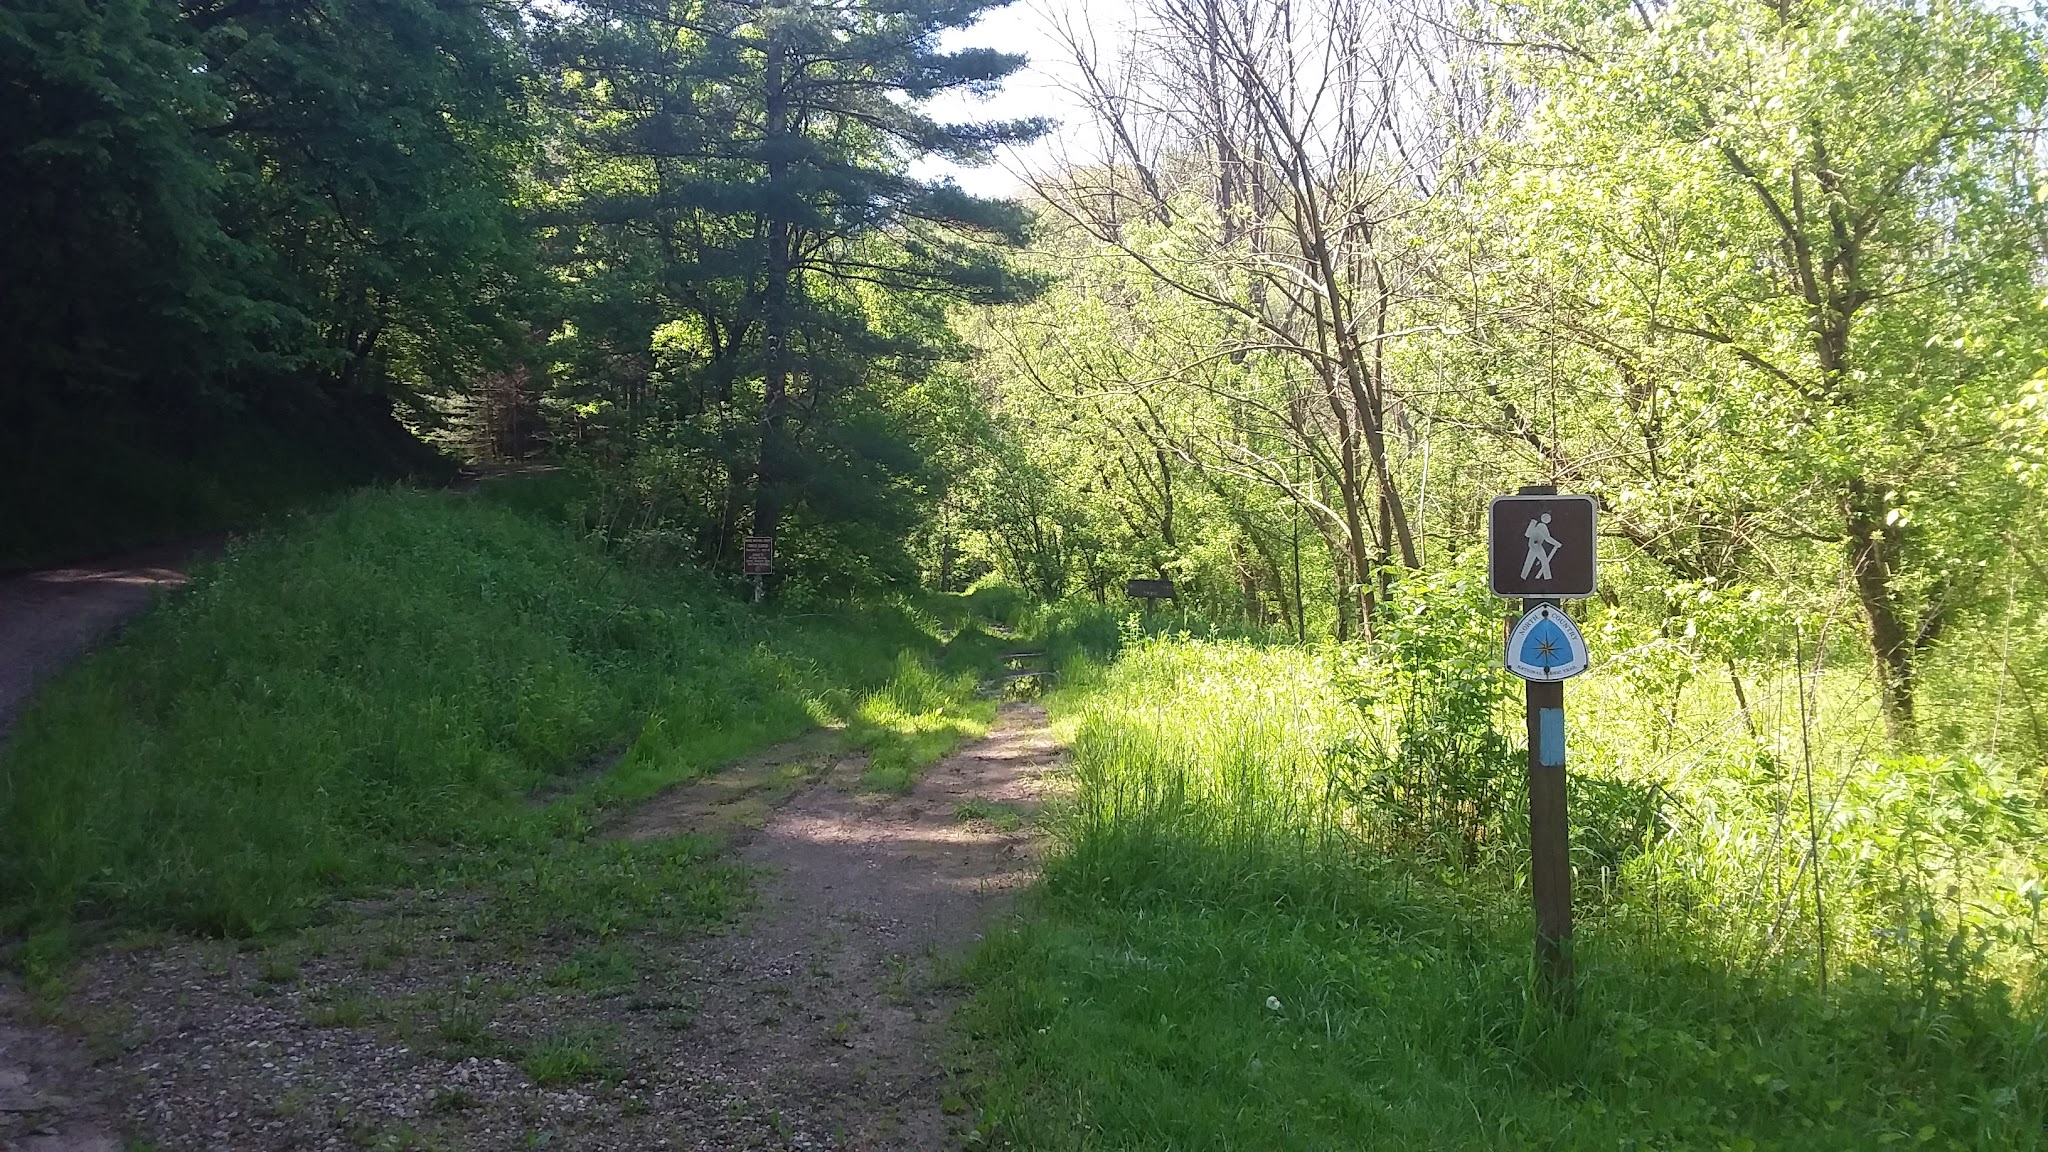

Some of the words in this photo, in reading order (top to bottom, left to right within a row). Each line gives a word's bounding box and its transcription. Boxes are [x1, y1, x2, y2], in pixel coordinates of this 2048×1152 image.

[1519, 614, 1539, 636] NORTH
[1551, 613, 1578, 640] COUNTRY
[1517, 665, 1542, 675] NATIONAL
[1563, 665, 1577, 673] TRAIL
